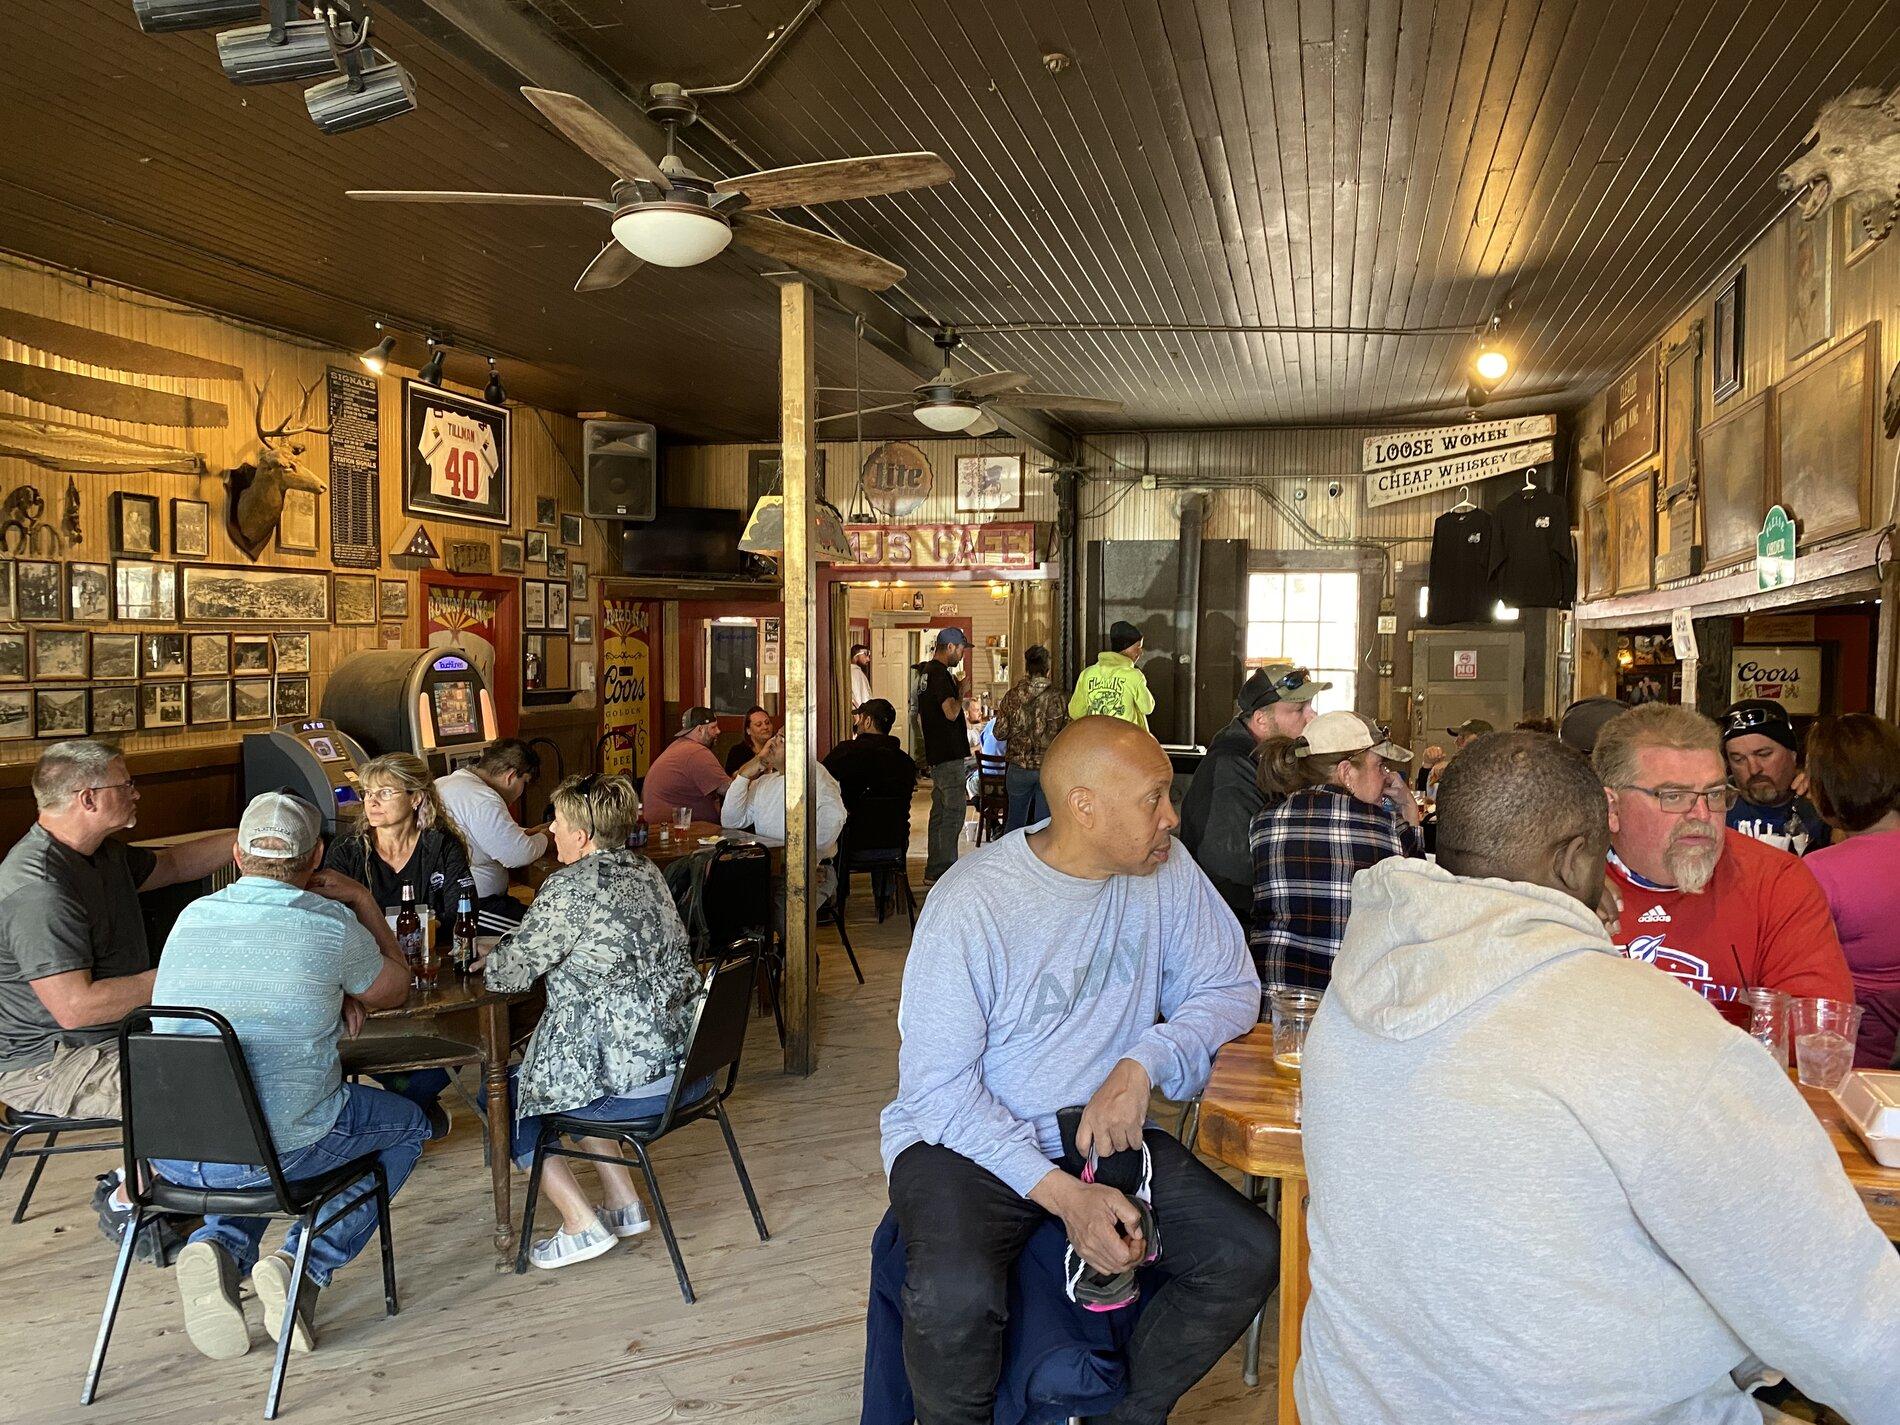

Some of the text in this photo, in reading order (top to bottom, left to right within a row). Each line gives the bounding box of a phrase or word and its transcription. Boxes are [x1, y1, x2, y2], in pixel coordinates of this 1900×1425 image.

[330, 371, 376, 390] SIGNALS
[448, 422, 475, 443] TILLMAN
[1375, 428, 1508, 464] LOOSE WOMEN
[445, 447, 479, 500] 40
[872, 463, 923, 492] Lite
[1378, 452, 1508, 491] CHEAP WHISKEY
[932, 530, 1026, 564] CAFE
[1457, 664, 1474, 674] NO
[1737, 661, 1800, 682] Coors
[603, 664, 645, 704] Coors
[1088, 676, 1126, 694] GLAMIS
[605, 707, 641, 717] GOLDEN
[303, 722, 324, 730] ATM
[613, 755, 632, 766] BEE
[1637, 914, 1672, 923] adidas
